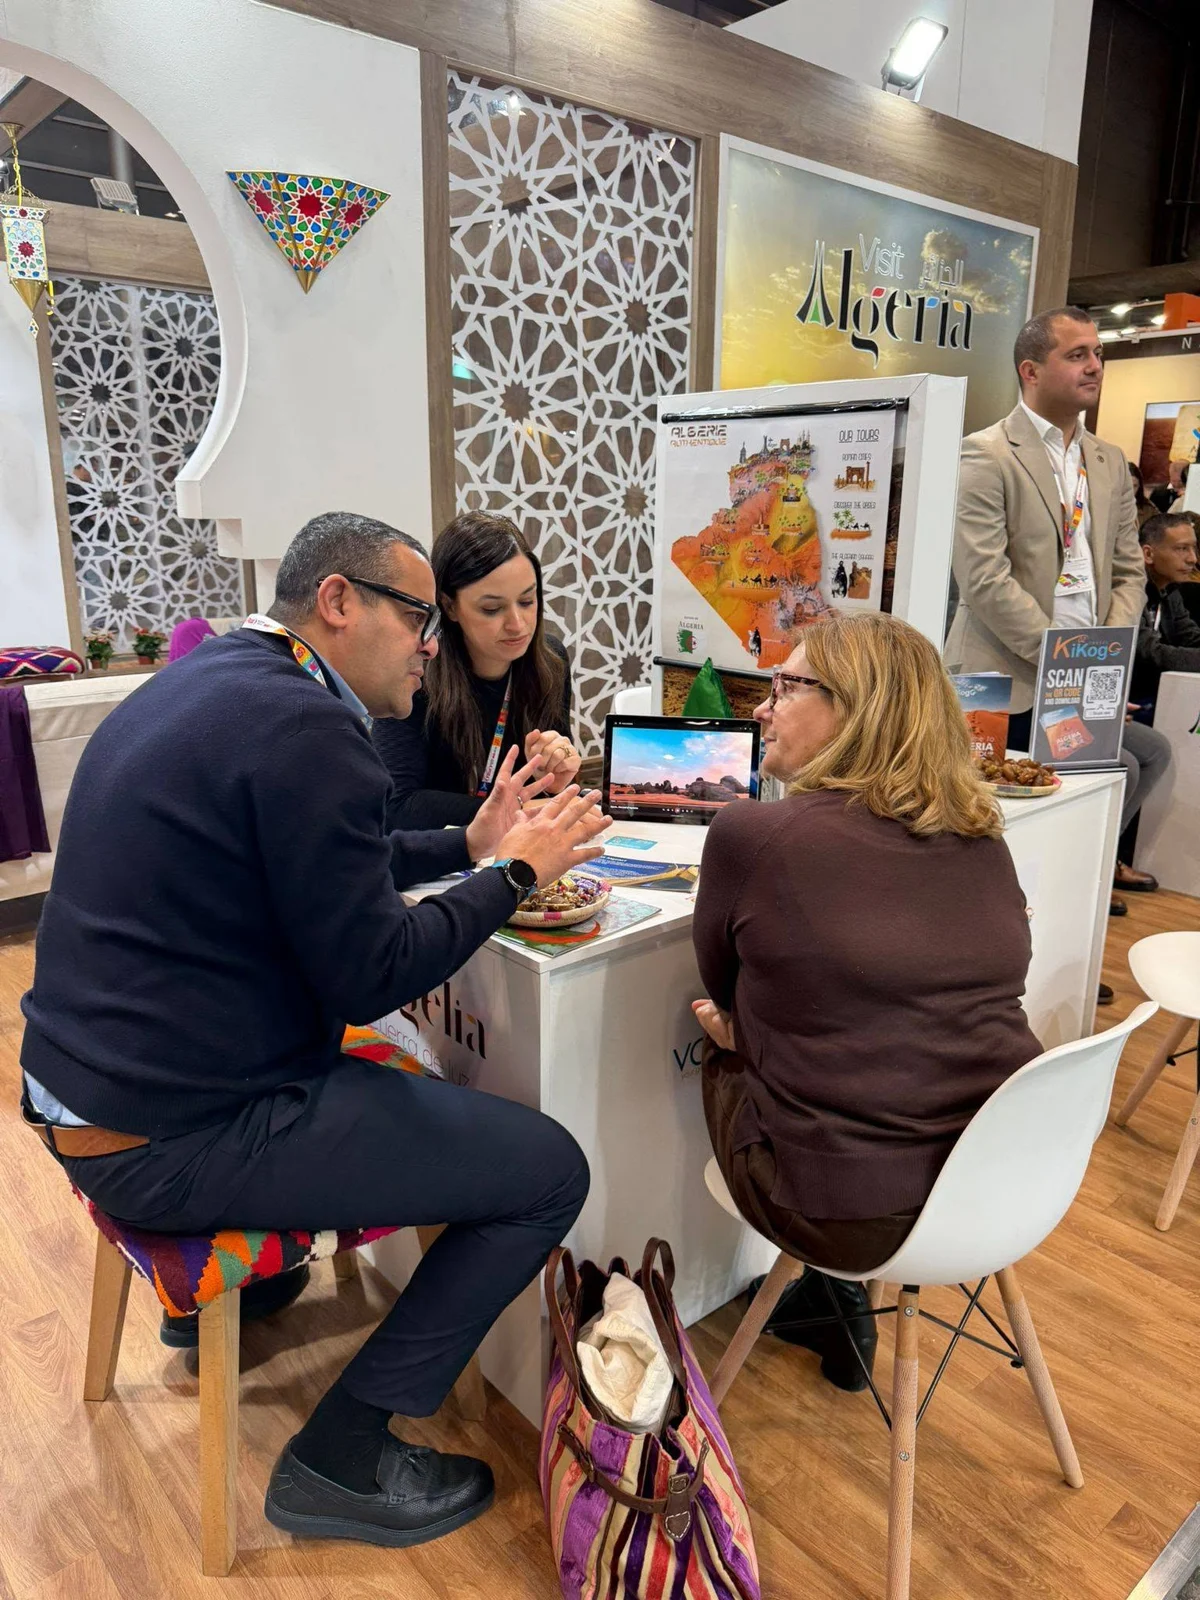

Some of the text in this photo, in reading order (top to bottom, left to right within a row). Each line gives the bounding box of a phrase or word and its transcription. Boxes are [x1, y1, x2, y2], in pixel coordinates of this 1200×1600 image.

[858, 233, 905, 279] Visit
[795, 239, 973, 370] Algeria
[1182, 336, 1193, 350] N
[671, 424, 727, 438] ALGERIE
[838, 428, 880, 443] OUR TOURS
[670, 438, 727, 447] AUTHENTIQUE
[679, 620, 704, 630] ALGERIA
[1046, 668, 1085, 688] SCAN
[1053, 688, 1063, 698] QR
[1064, 687, 1081, 697] CODE
[971, 742, 994, 751] ERIA
[423, 1047, 444, 1075] de
